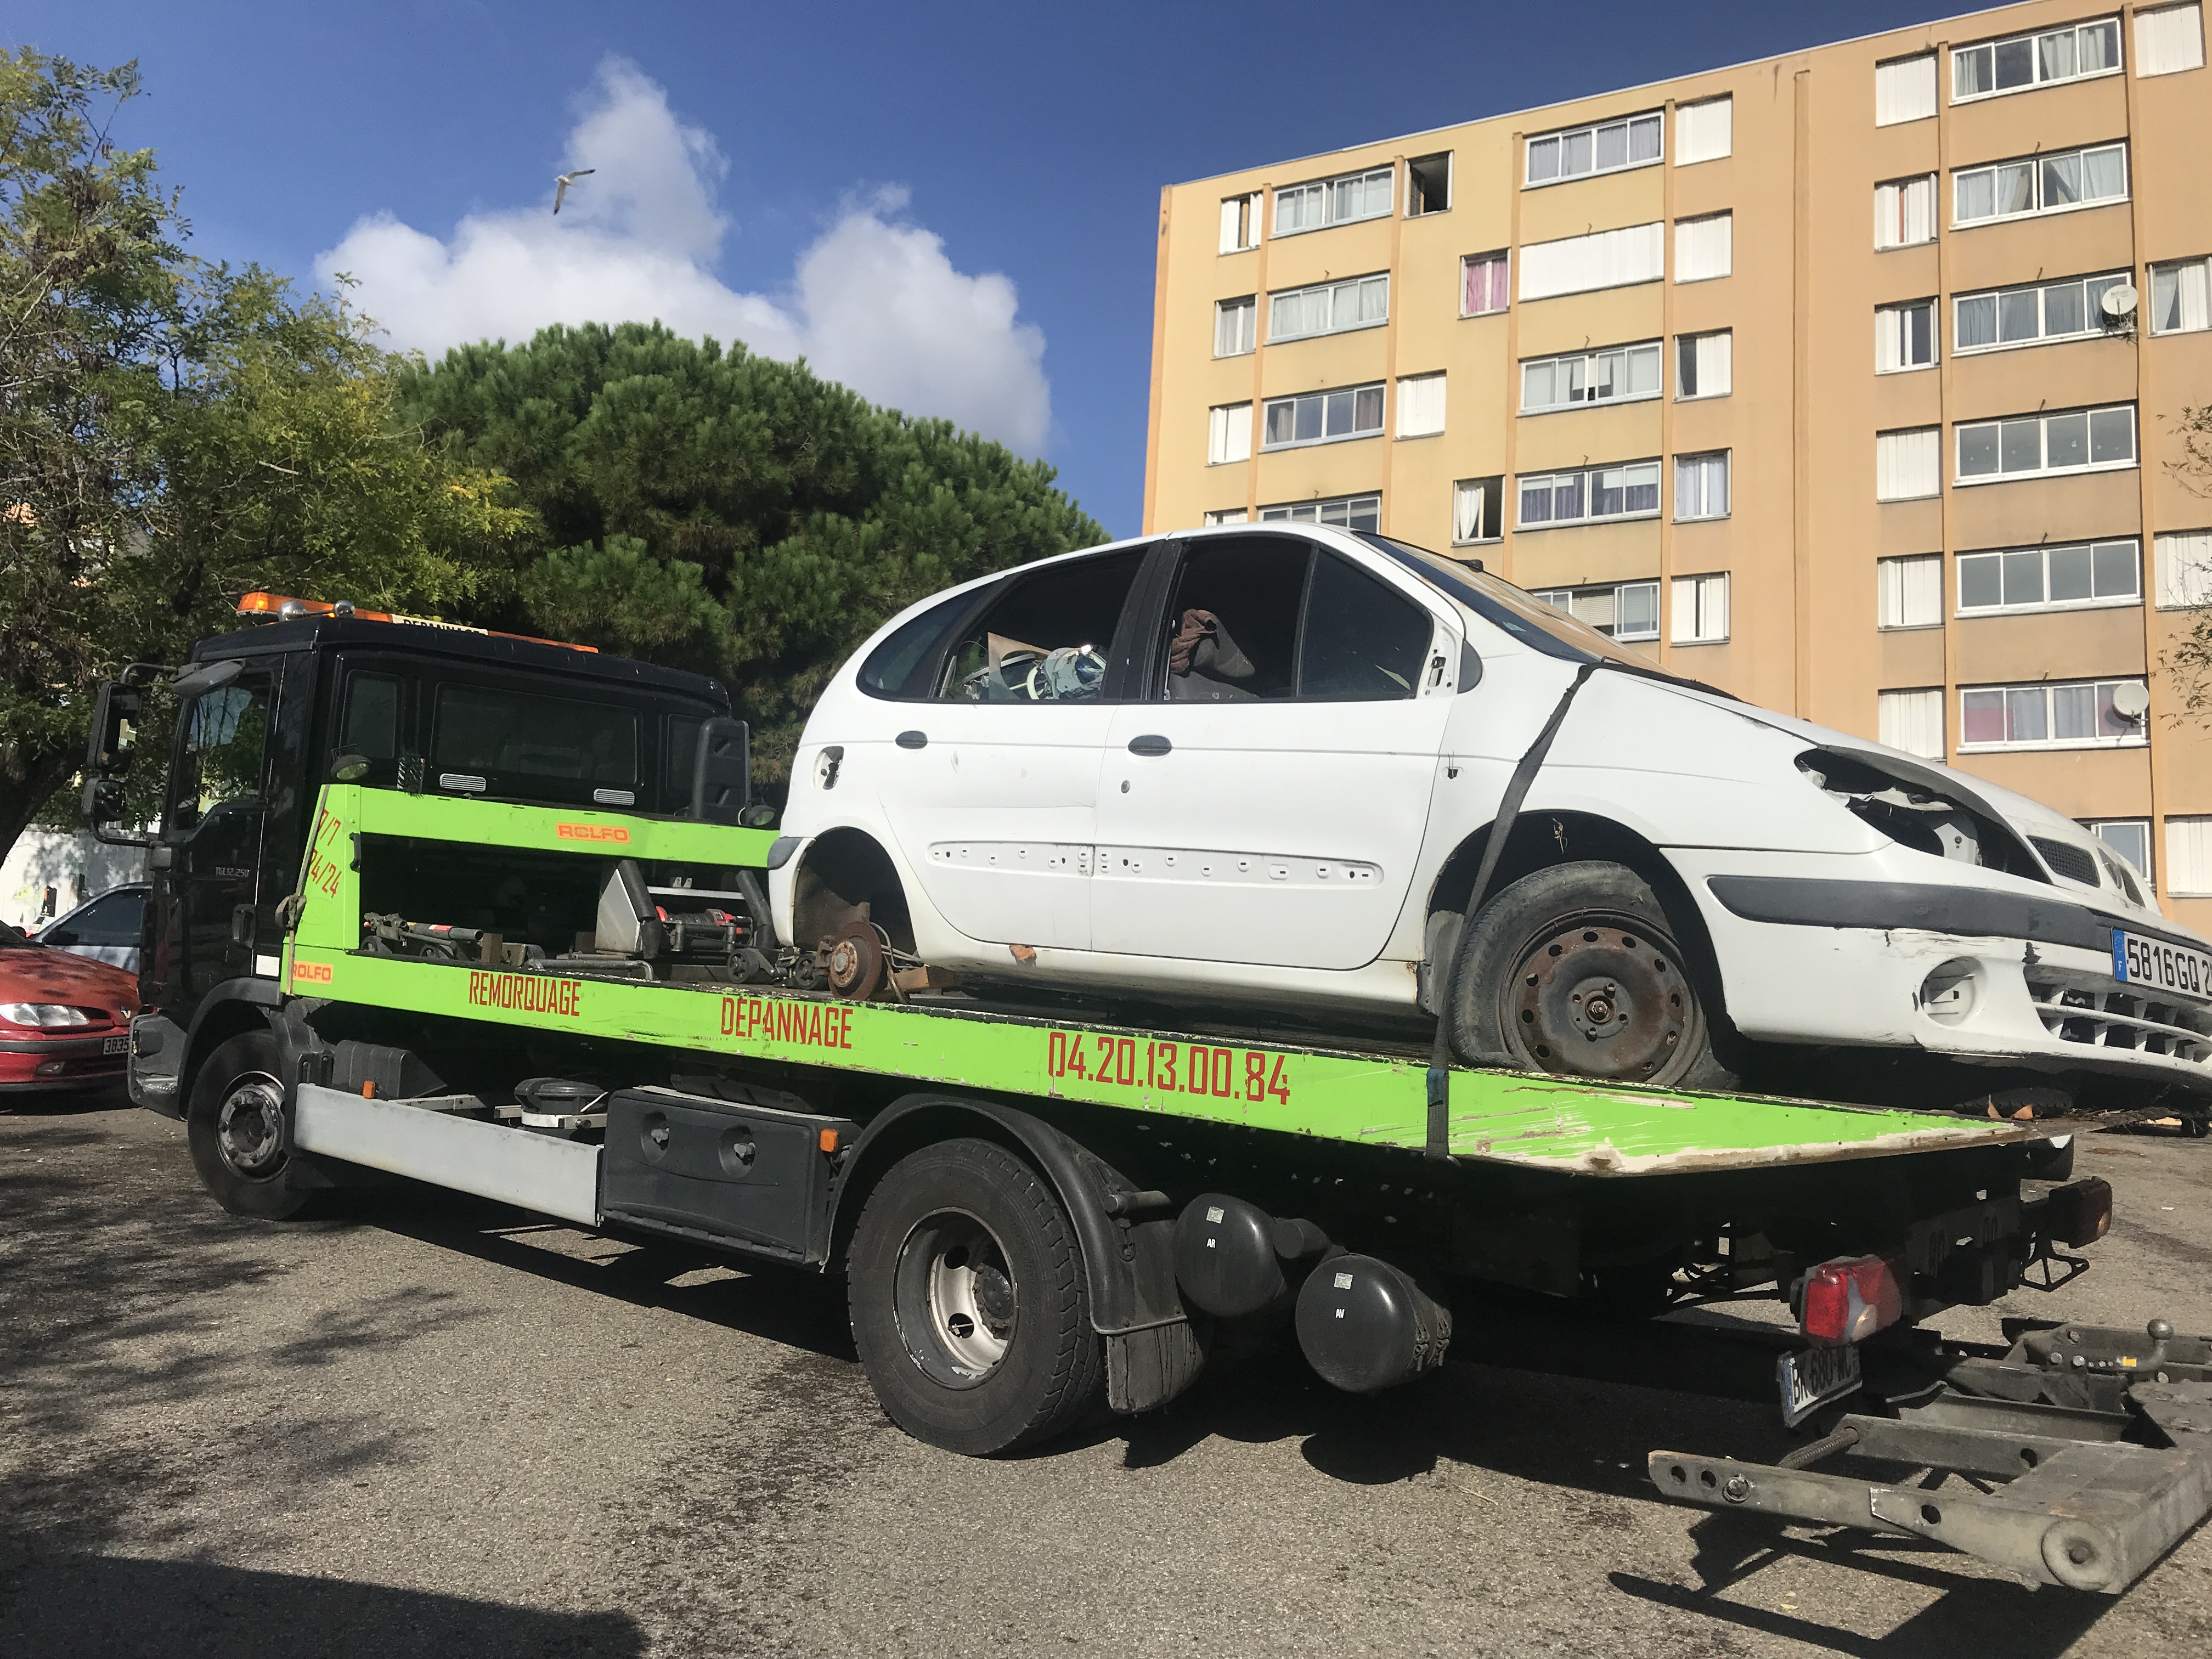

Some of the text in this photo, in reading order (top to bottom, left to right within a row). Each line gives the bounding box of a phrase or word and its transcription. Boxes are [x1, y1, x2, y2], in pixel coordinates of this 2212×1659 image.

[2127, 938, 2212, 996] 5816GQ 2
[469, 971, 582, 1017] REMORQUAGE
[721, 997, 854, 1049] DEPANNAGE
[1048, 1031, 1290, 1105] 04.20.13.00.84
[1207, 1238, 1216, 1248] AR
[1335, 1309, 1345, 1318] AV
